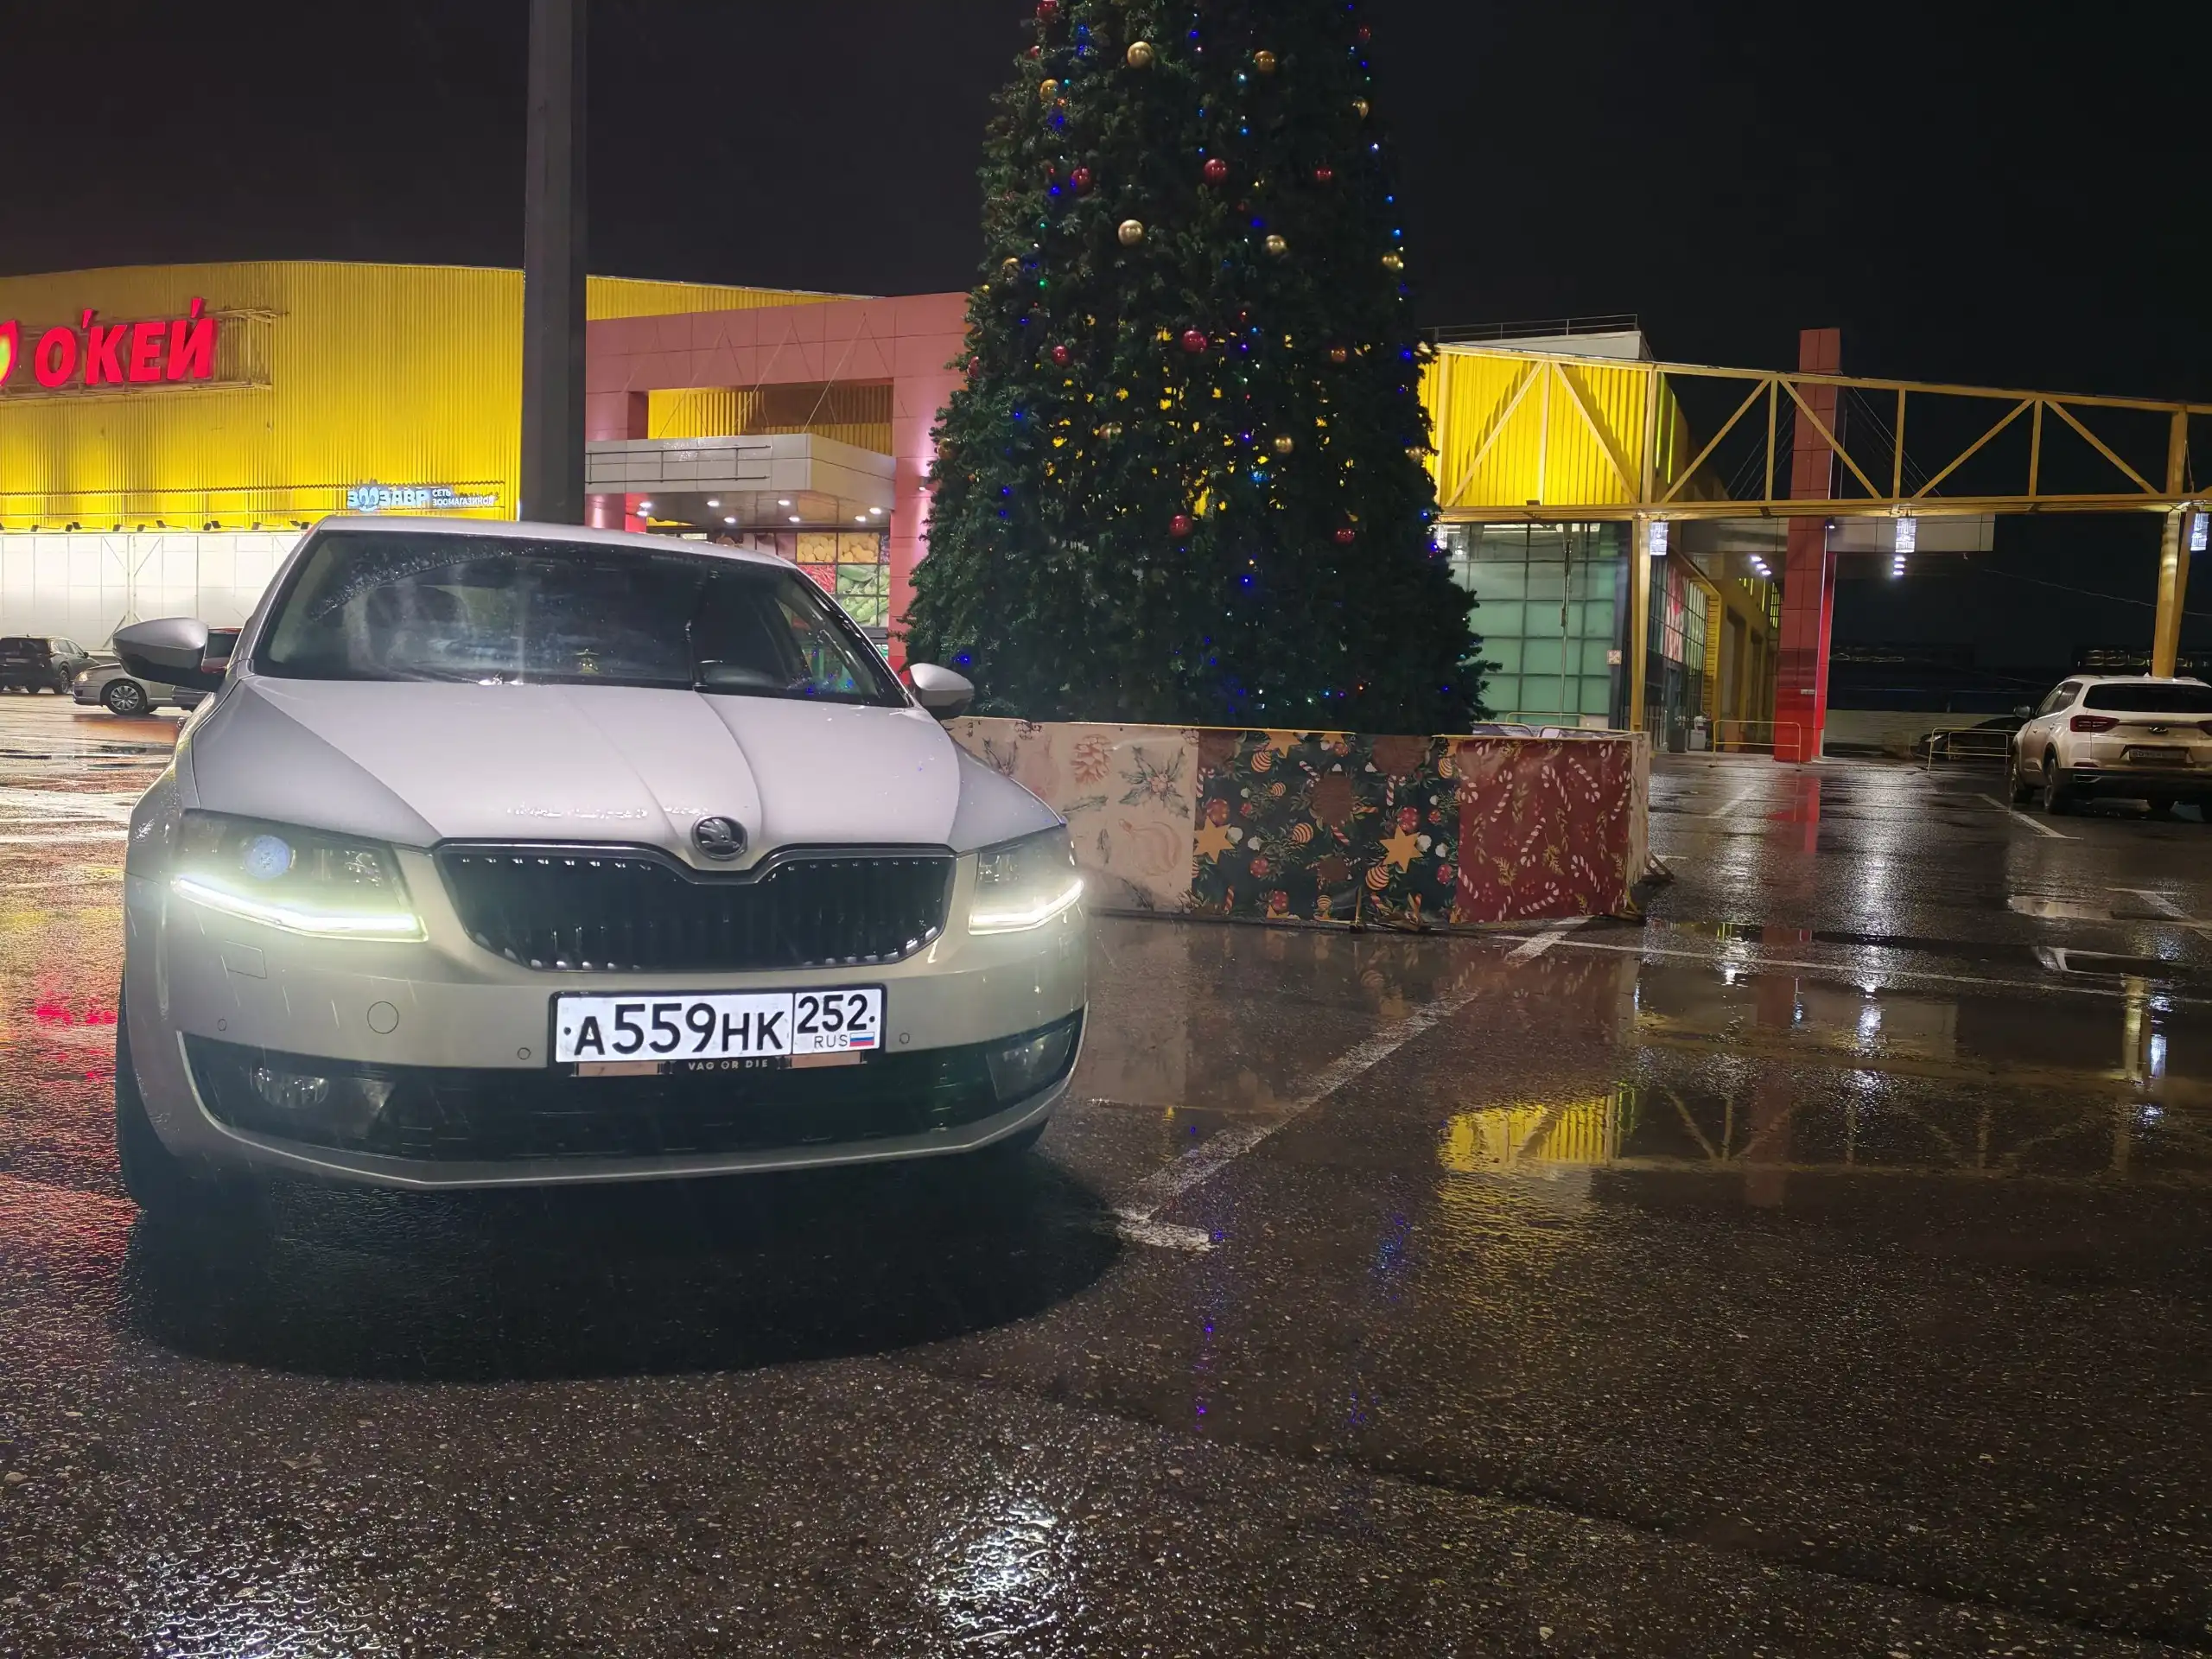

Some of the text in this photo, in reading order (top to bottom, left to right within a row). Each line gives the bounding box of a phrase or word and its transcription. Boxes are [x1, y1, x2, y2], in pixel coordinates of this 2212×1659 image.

[347, 486, 429, 510] ЗООЗАВР
[432, 488, 451, 497] СЕТЬ
[432, 495, 495, 506] ЗООМАГАЗИНОВ
[797, 994, 868, 1034] 252
[814, 1034, 848, 1048] RUS
[688, 1059, 768, 1071] VAG OR DIE
